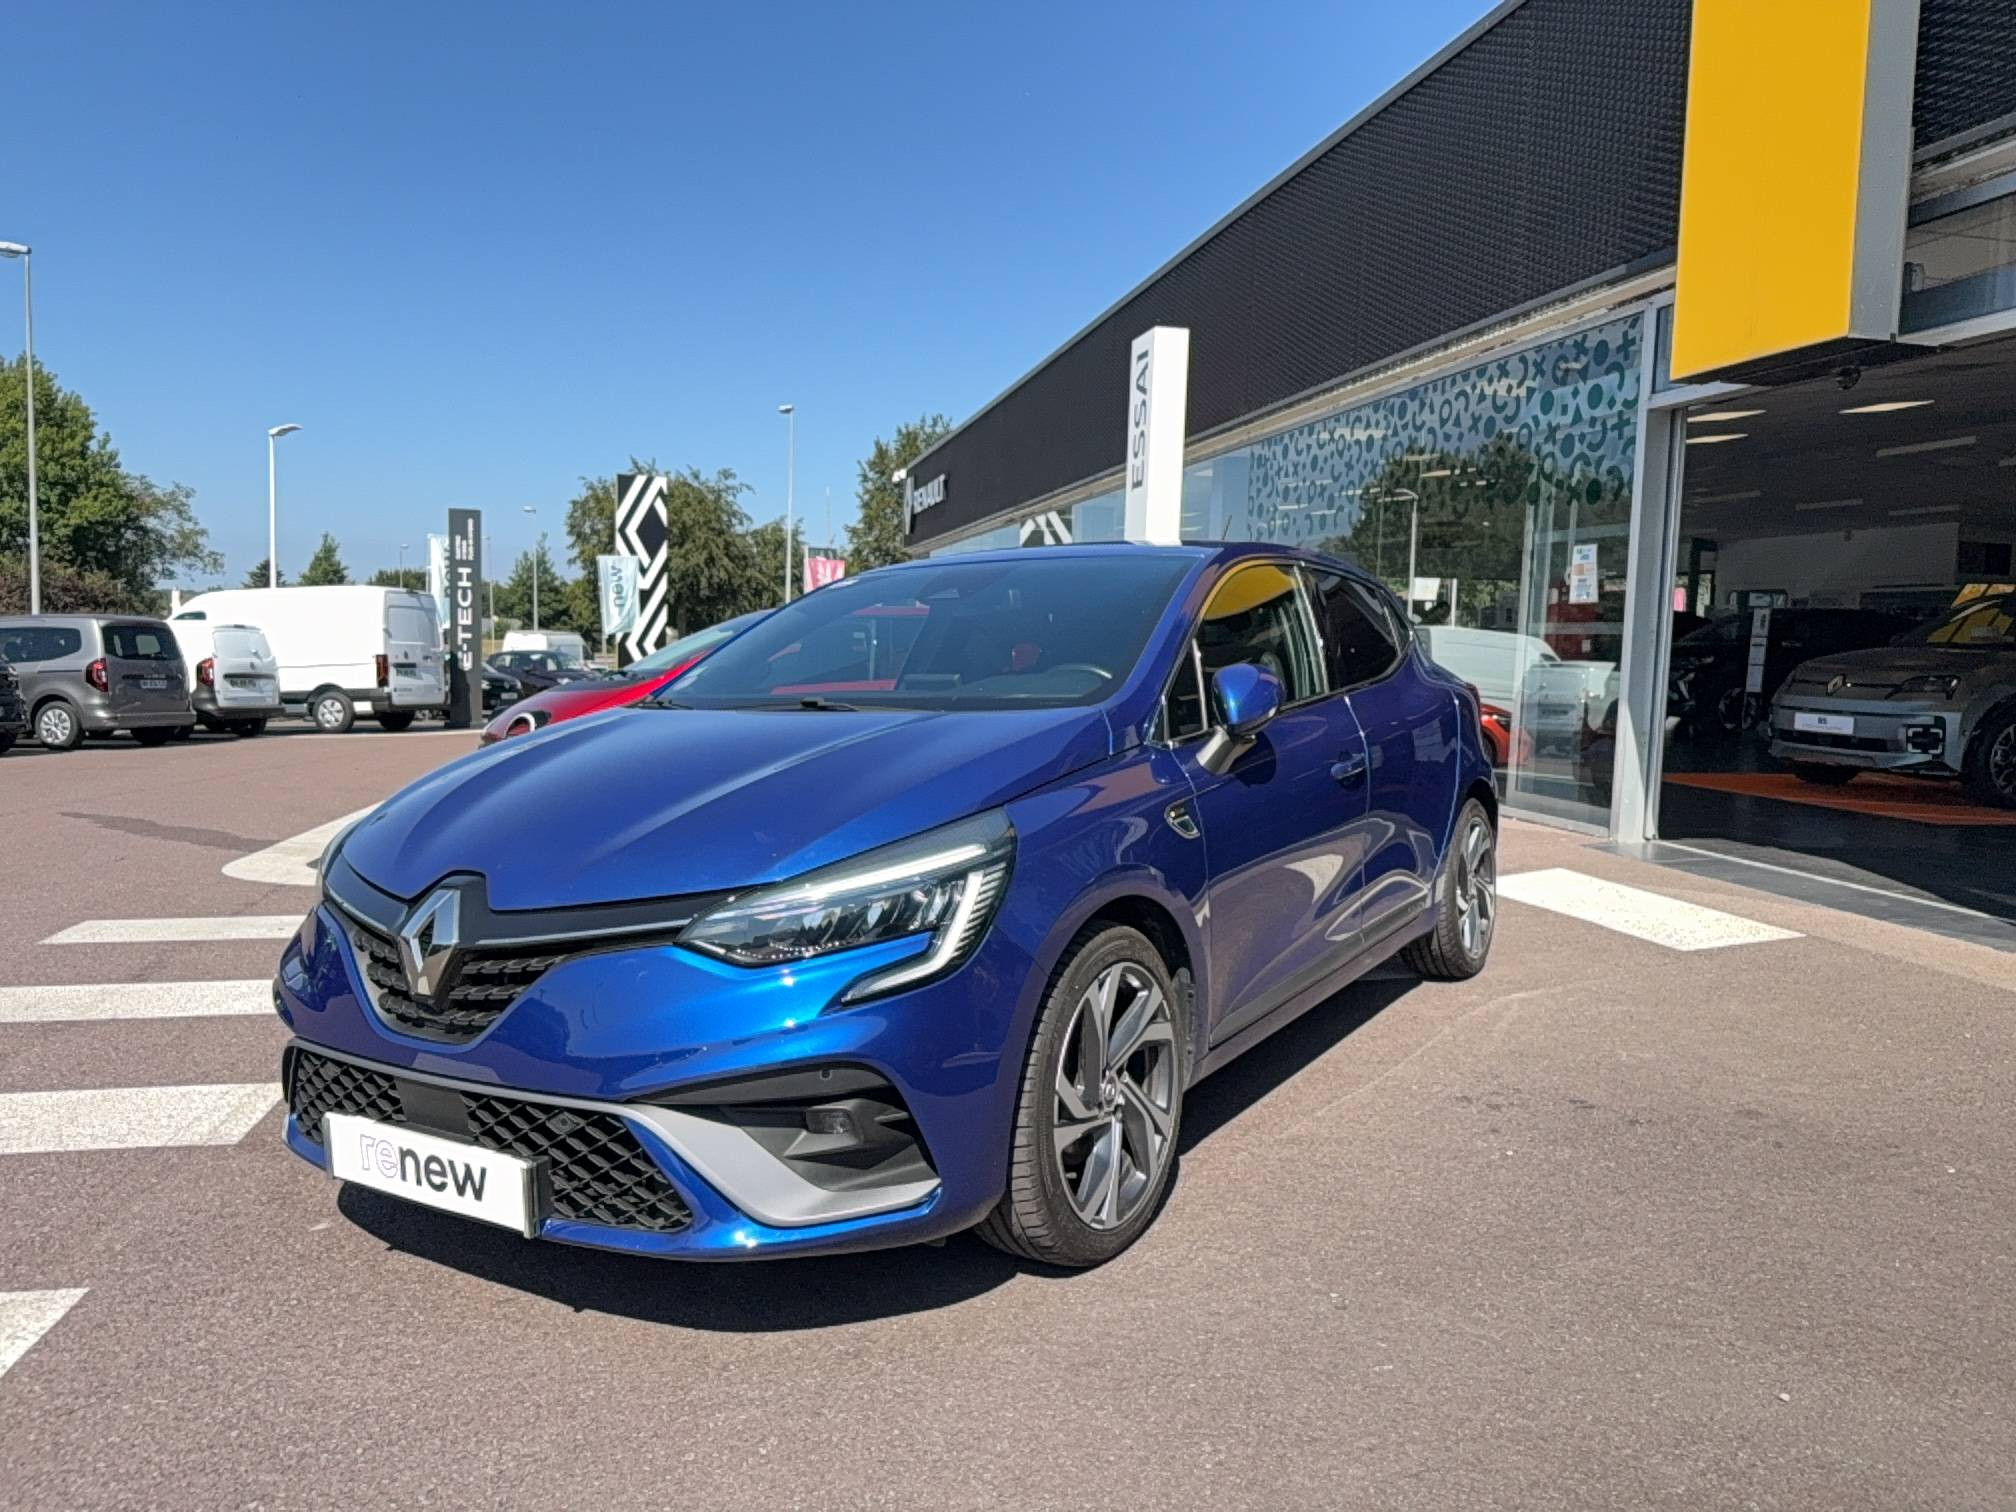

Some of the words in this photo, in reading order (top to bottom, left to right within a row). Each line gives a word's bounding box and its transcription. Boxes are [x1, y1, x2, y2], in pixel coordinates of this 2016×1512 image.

[1131, 349, 1149, 491] ESSAI
[456, 566, 472, 671] E-TECH
[359, 1133, 487, 1202] renew
